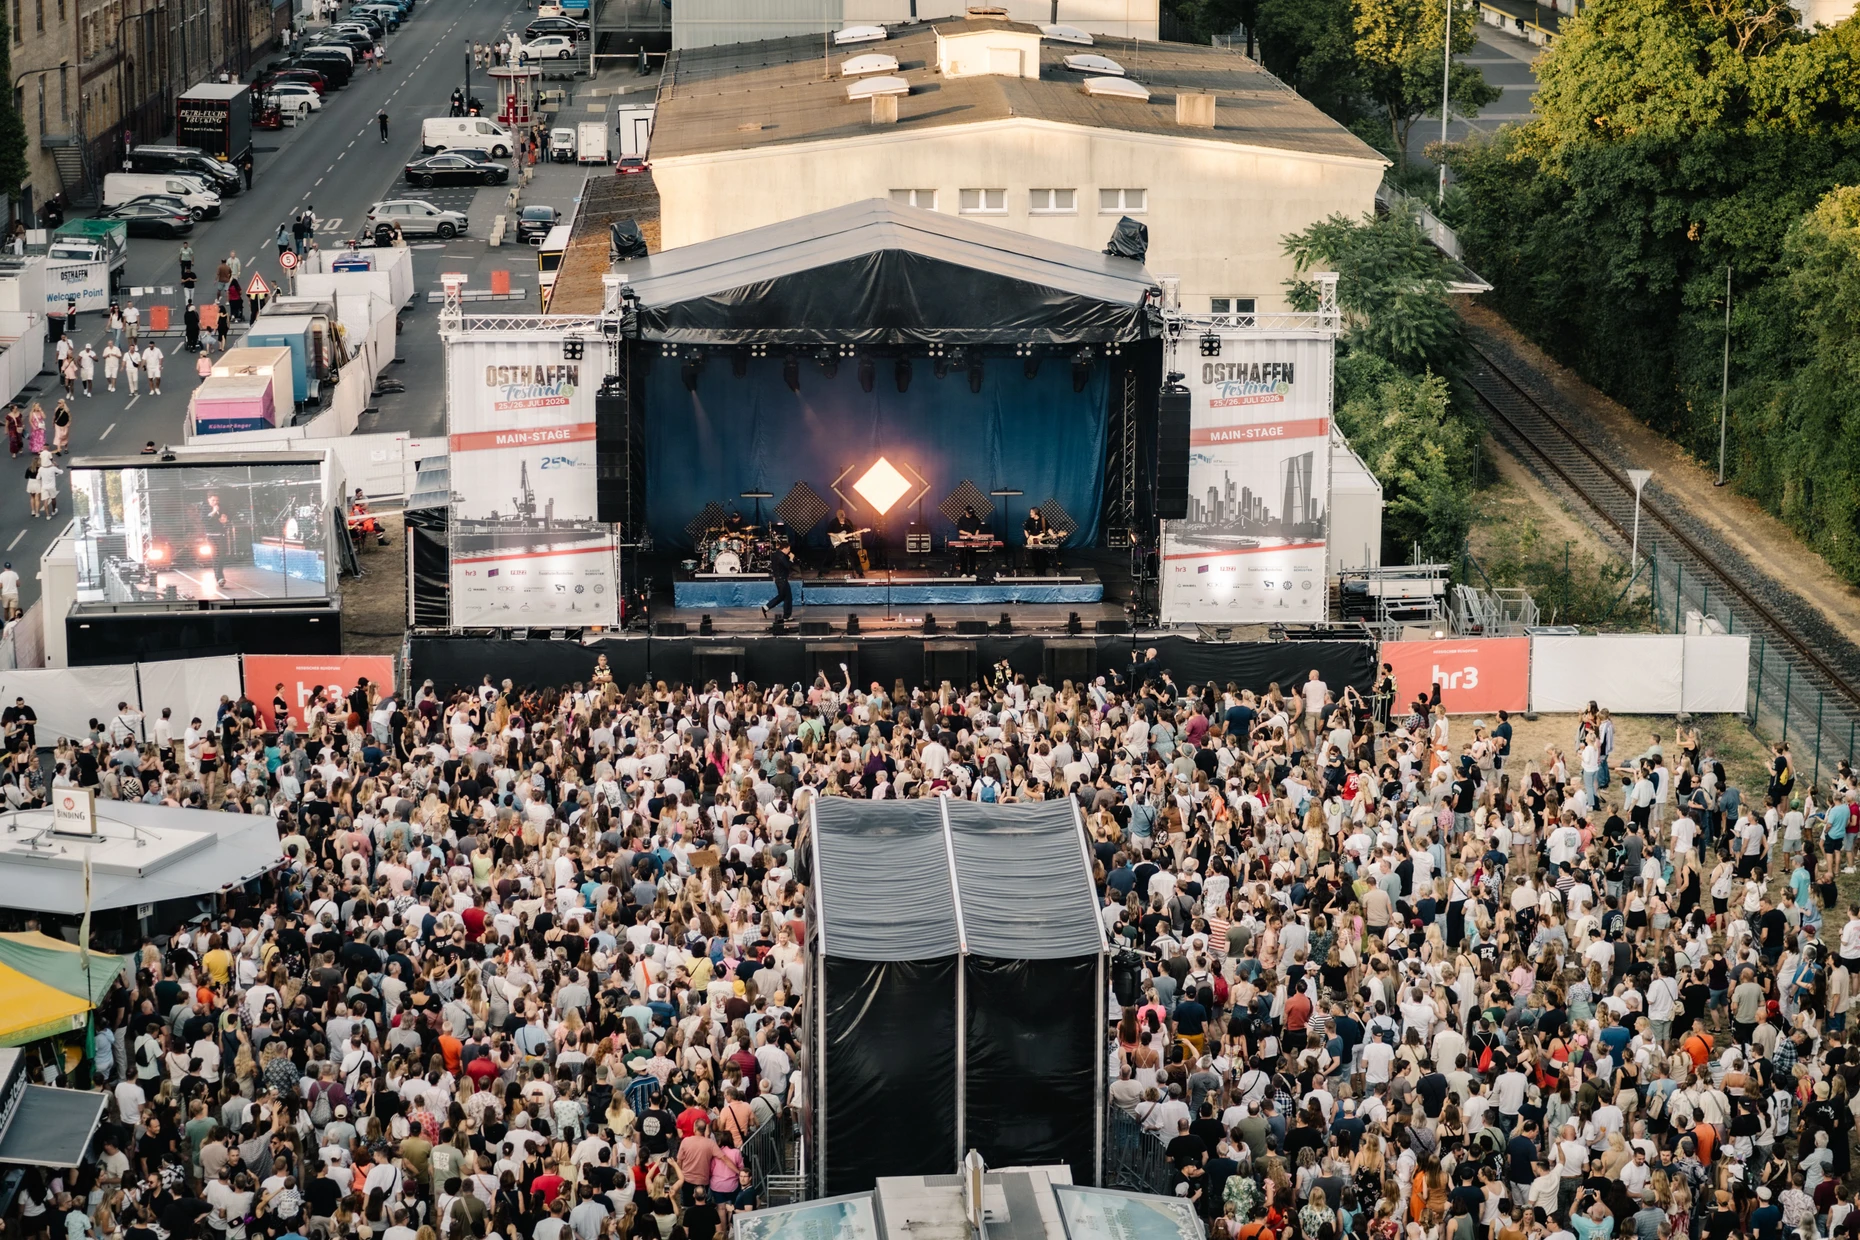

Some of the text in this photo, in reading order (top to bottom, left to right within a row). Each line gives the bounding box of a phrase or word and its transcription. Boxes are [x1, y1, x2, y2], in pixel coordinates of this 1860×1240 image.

[180, 110, 228, 118] PETRI-FUCHS
[61, 269, 89, 281] OSTHAFEN
[46, 288, 104, 302] Welcome Point
[486, 364, 579, 387] OSTHAFEN
[1202, 362, 1295, 385] OSTHAFEN
[500, 381, 563, 402] Festival
[1215, 379, 1279, 400] Festival
[527, 399, 544, 407] JULI
[1242, 396, 1259, 405] JULI
[496, 429, 571, 444] MAIN-STAGE
[1210, 426, 1284, 441] MAIN-STAGE
[1432, 664, 1479, 690] hr3
[297, 681, 343, 708] h3
[57, 808, 86, 821] BINDING
